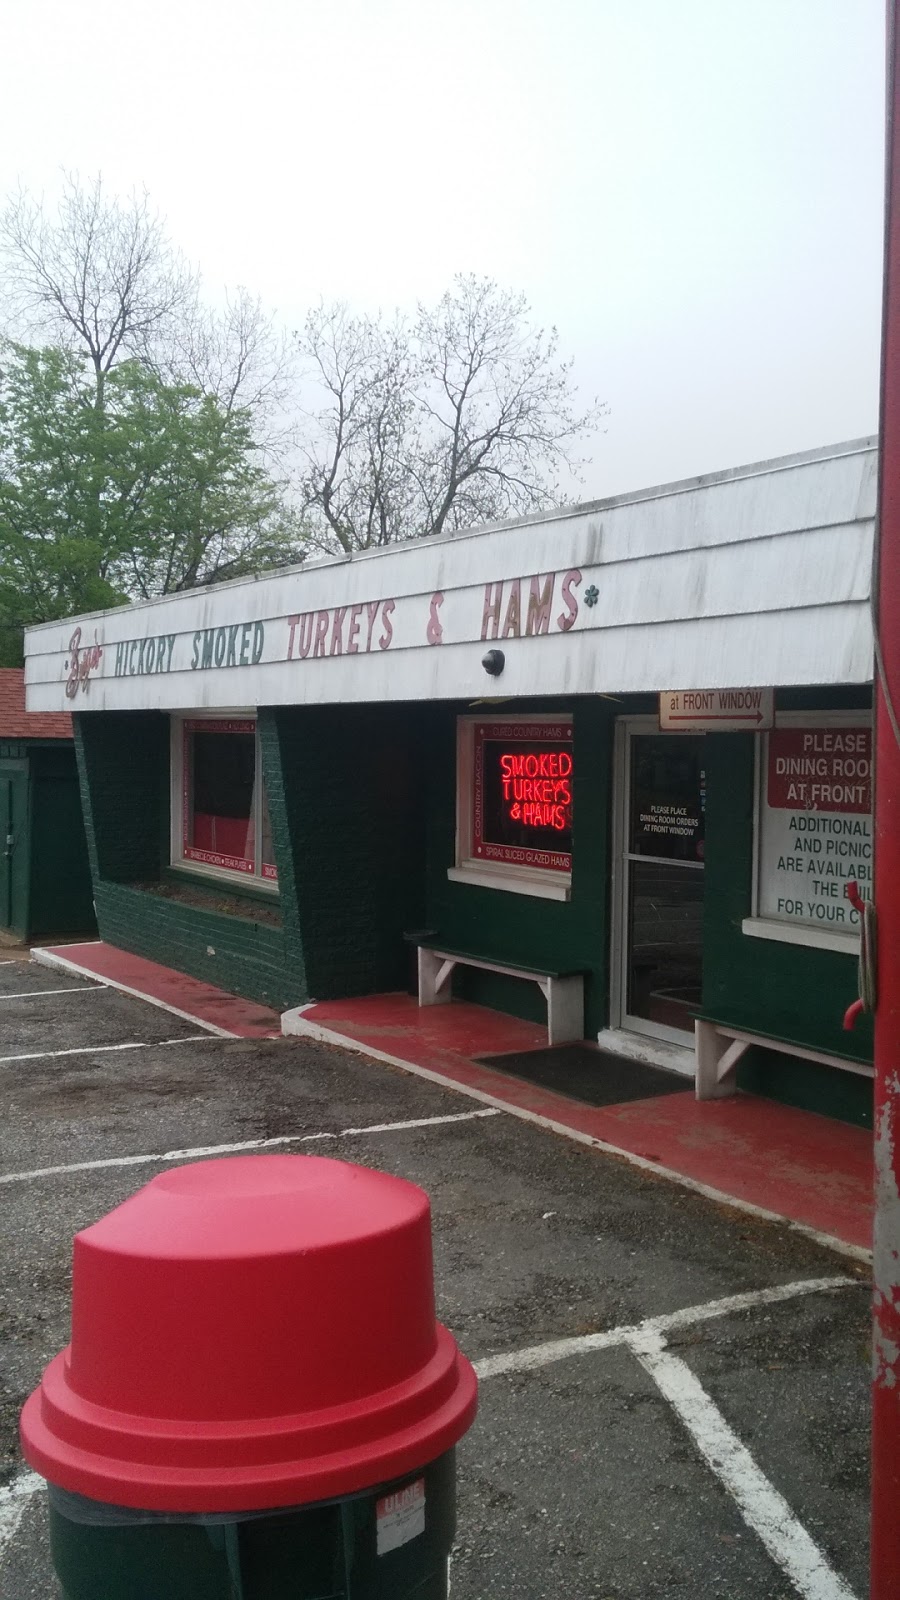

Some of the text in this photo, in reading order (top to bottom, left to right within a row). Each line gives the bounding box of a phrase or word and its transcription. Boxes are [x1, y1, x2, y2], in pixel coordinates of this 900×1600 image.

[115, 634, 176, 677] HICKORY
[191, 621, 265, 670] SMOKED
[287, 599, 396, 660] TURKEYS
[426, 591, 445, 645] &
[480, 568, 583, 641] HAMS
[670, 691, 762, 710] at FRONT WINDOW
[514, 726, 542, 737] COUNTRY
[543, 728, 562, 738] HAMS
[803, 734, 866, 753] PLEASE
[501, 752, 573, 779] SMOKED
[775, 757, 873, 778] DINING ROO
[503, 778, 571, 805] TURKEYS
[786, 783, 866, 804] AT FRONT
[510, 802, 566, 830] & HAMS
[640, 814, 699, 827] DINING ROOM ORDERS
[650, 805, 688, 816] PLEASE PLACE
[643, 823, 695, 836] AT FRONT WINDOW
[789, 816, 871, 837] ADDITIONAL
[485, 847, 570, 868] SPIRAL SLICED GLAZED HAMS
[794, 837, 872, 859] AND PICNIC
[777, 856, 804, 873] ARE
[812, 880, 839, 898] THE
[777, 898, 803, 916] FOR
[808, 902, 845, 922] YOUR
[384, 1482, 420, 1513] ULINE
